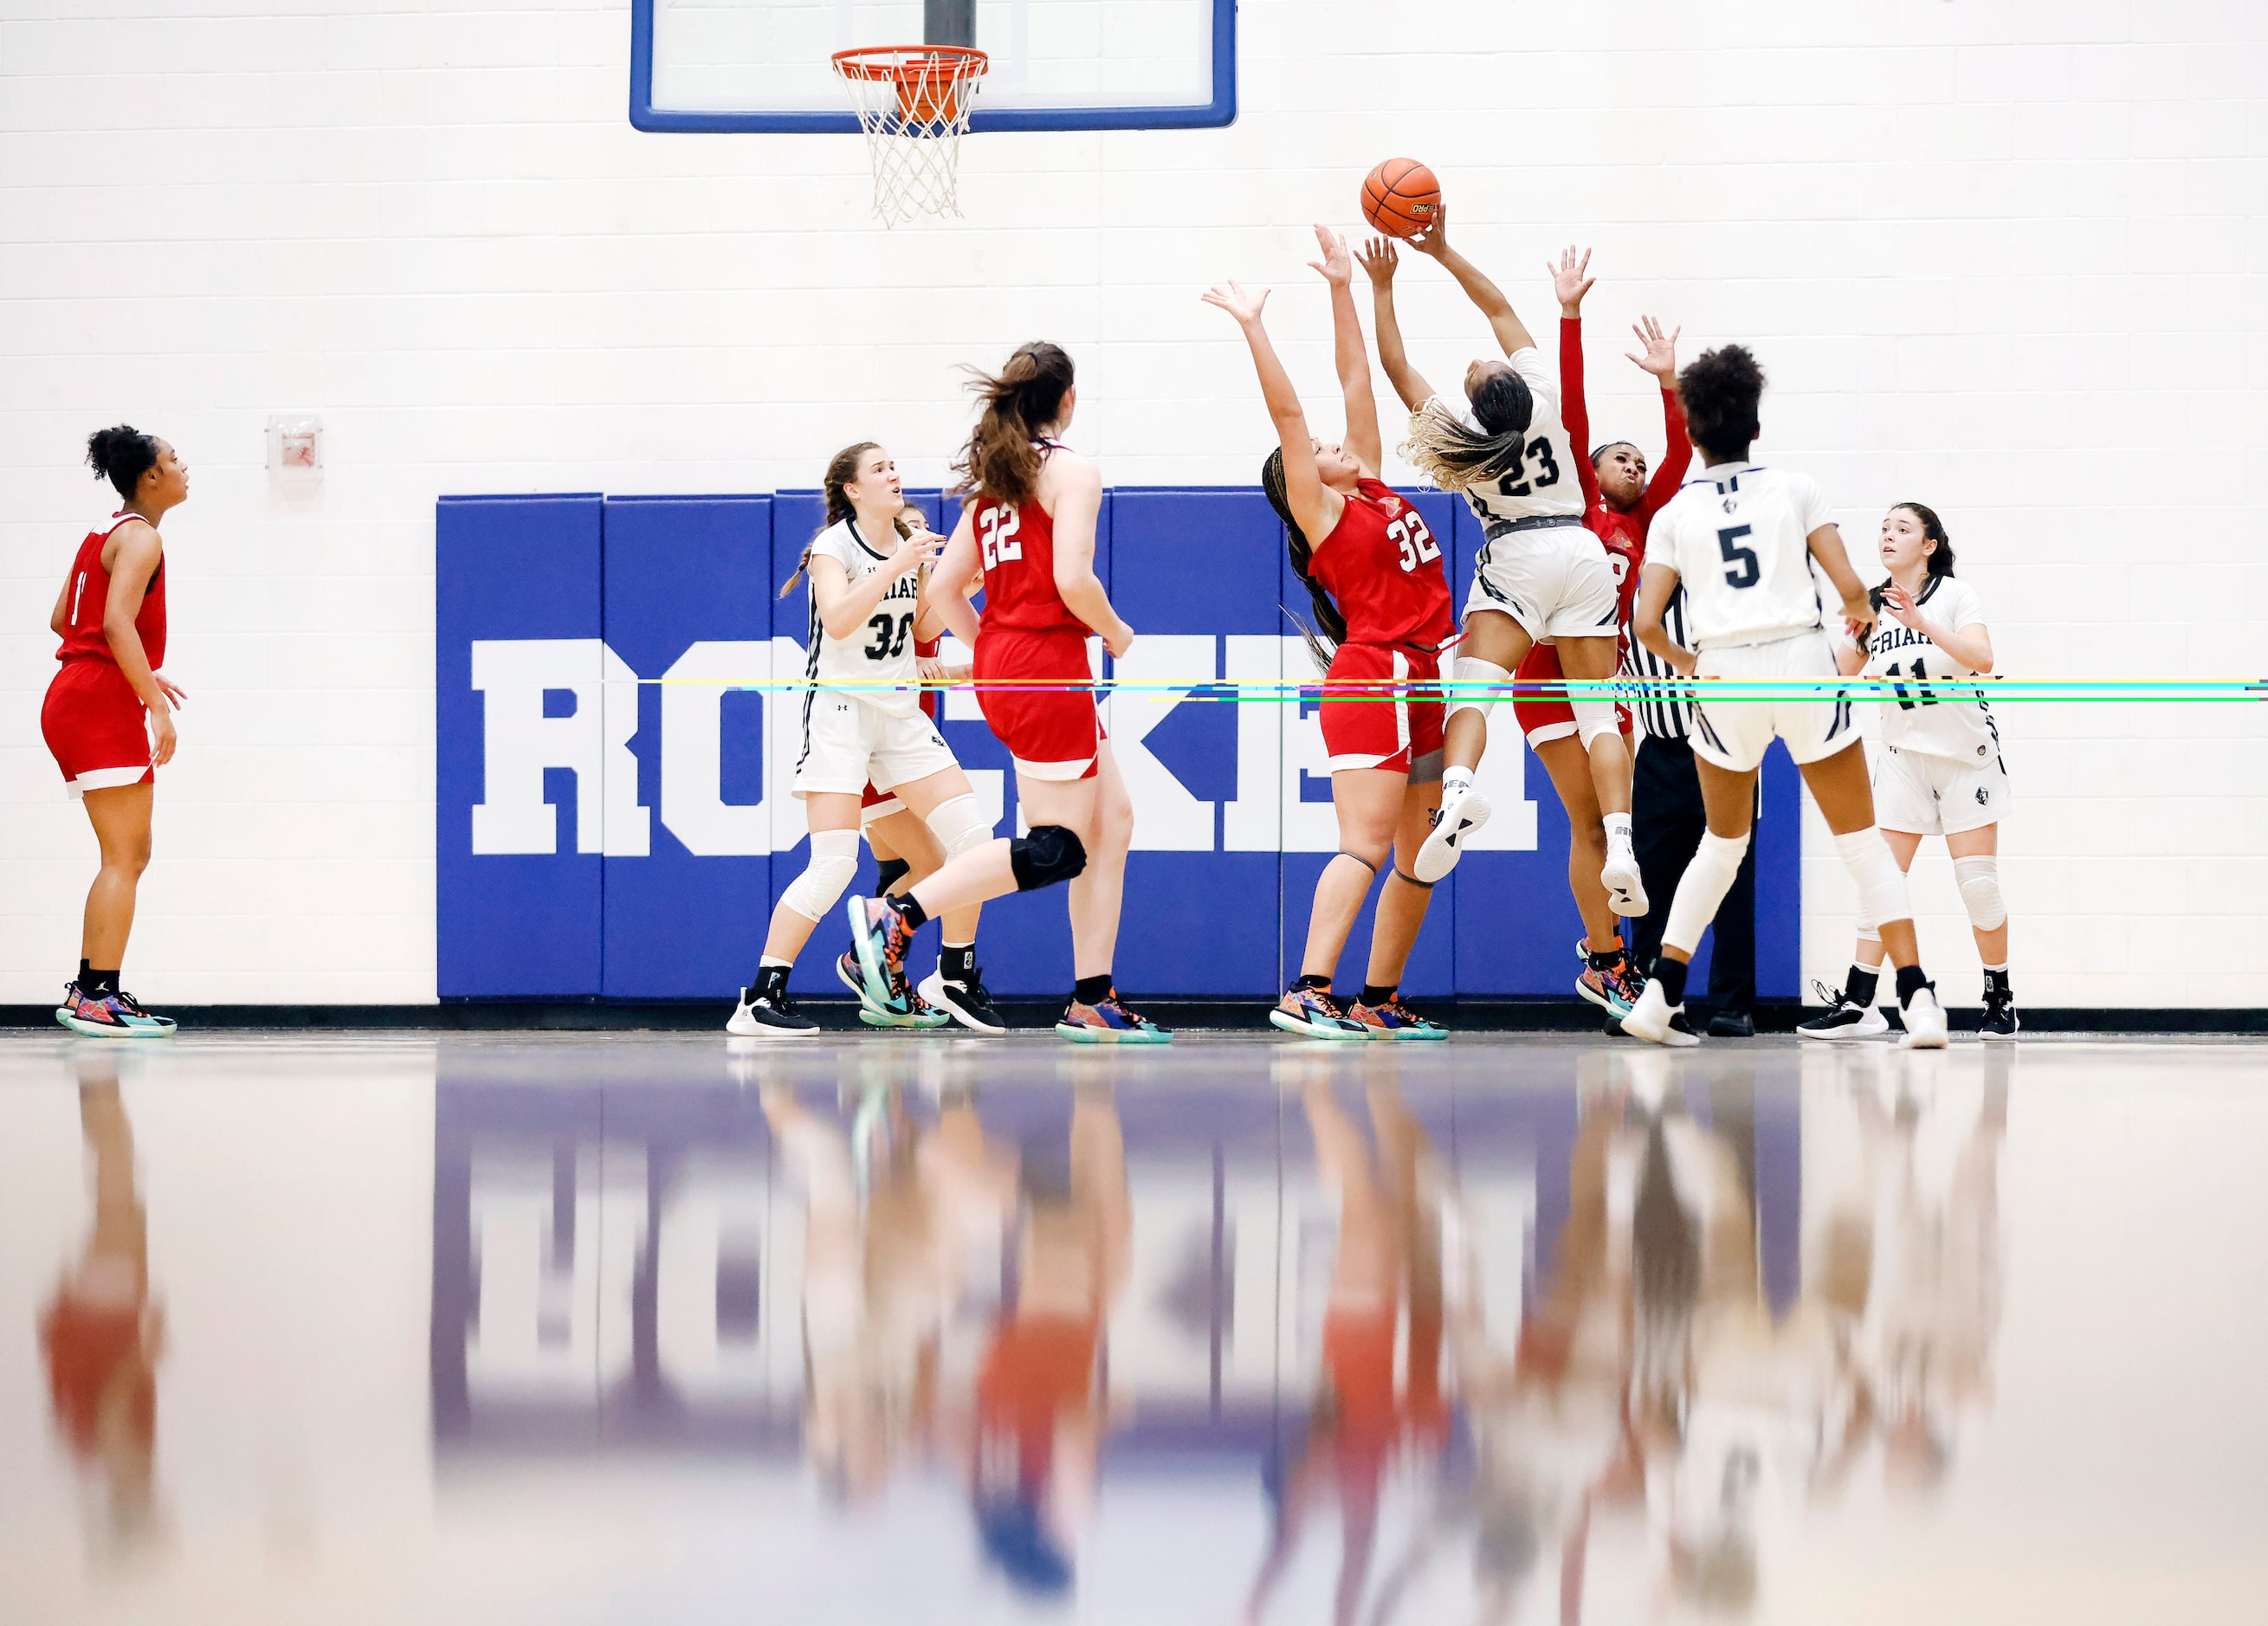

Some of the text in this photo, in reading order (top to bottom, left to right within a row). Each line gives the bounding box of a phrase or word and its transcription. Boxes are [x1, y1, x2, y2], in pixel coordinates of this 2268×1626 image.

[1498, 436, 1560, 496] 23
[979, 501, 1023, 571] 22
[1386, 510, 1442, 573] 32
[1717, 524, 1761, 589] 5
[863, 612, 915, 660] 30
[1885, 657, 1939, 711] 11
